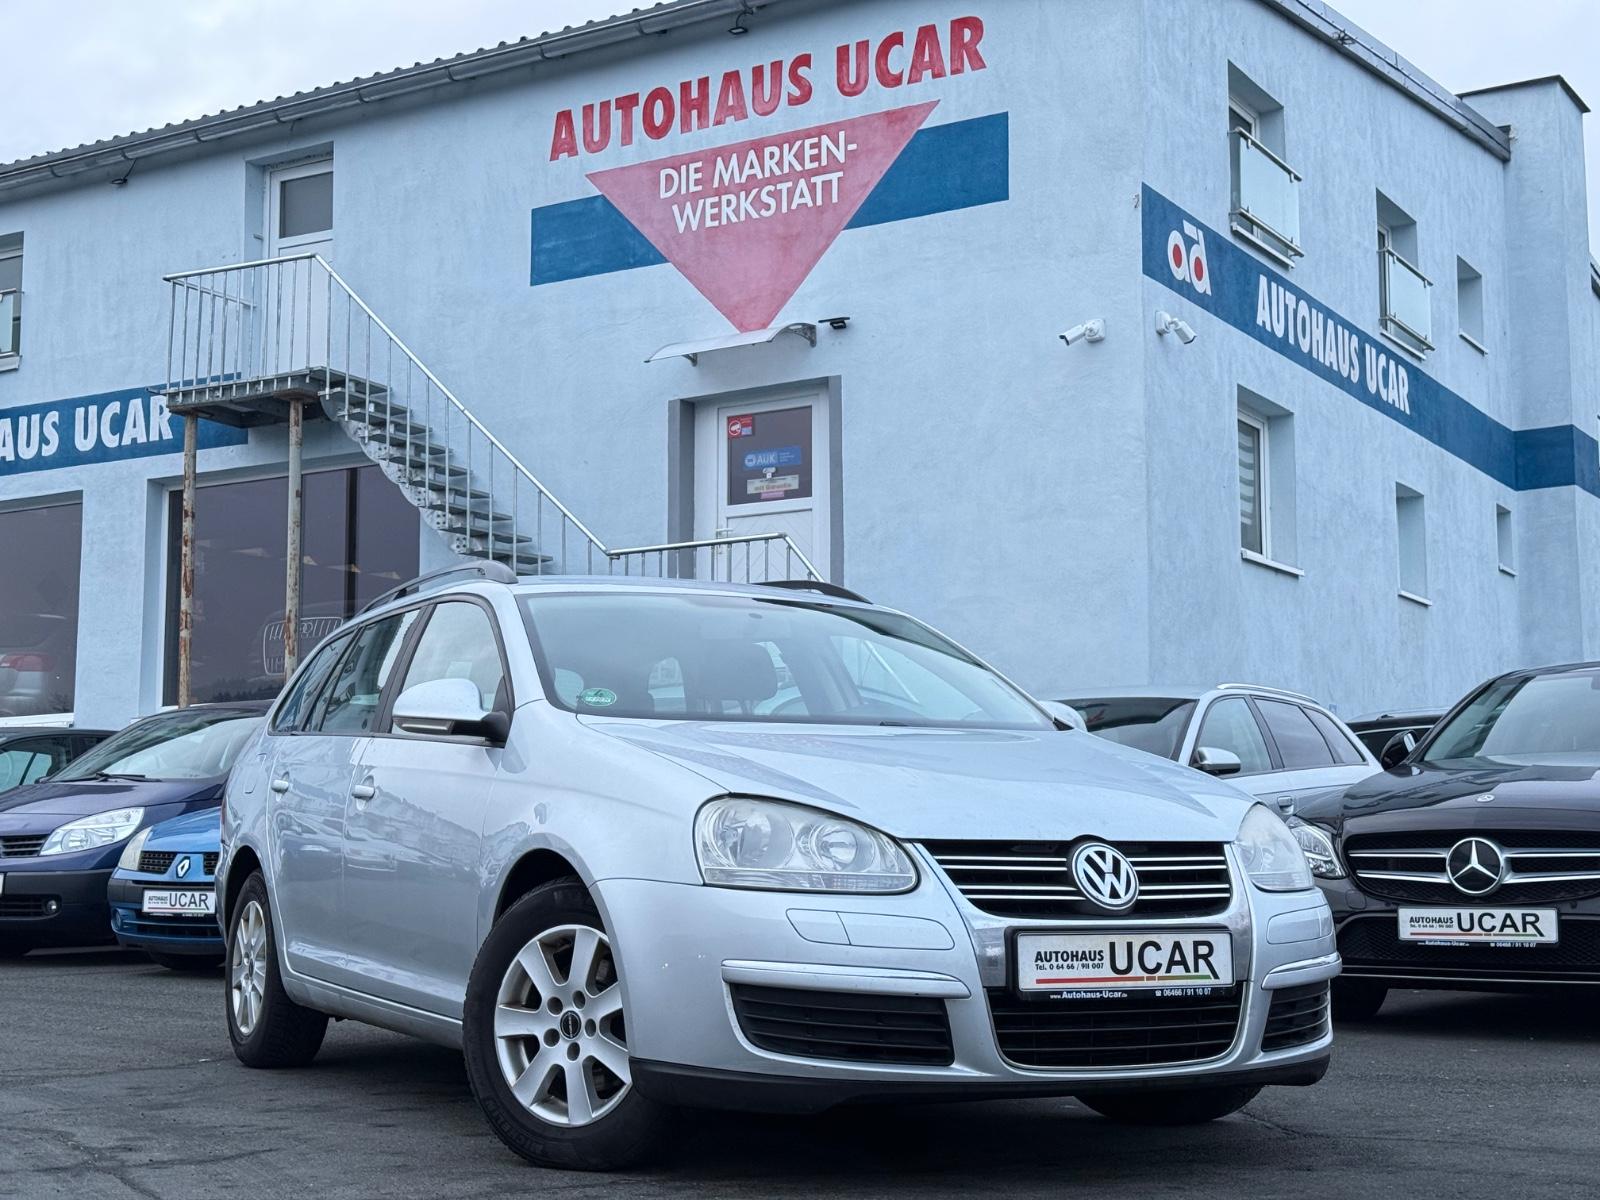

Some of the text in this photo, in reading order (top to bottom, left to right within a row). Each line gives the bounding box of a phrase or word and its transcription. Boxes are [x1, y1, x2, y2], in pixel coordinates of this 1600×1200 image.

[549, 15, 987, 161] AUTOHAUS UCAR
[659, 130, 858, 199] DIE MARKEN-
[672, 171, 844, 233] WERKSTATT
[1256, 274, 1411, 415] AUTOHAUS UCAR
[74, 395, 173, 452] UCAR
[169, 893, 209, 911] UCAR
[1409, 912, 1545, 937] AUTOHAUS UCAR
[1034, 940, 1220, 980] AUTOHAUS UCAR
